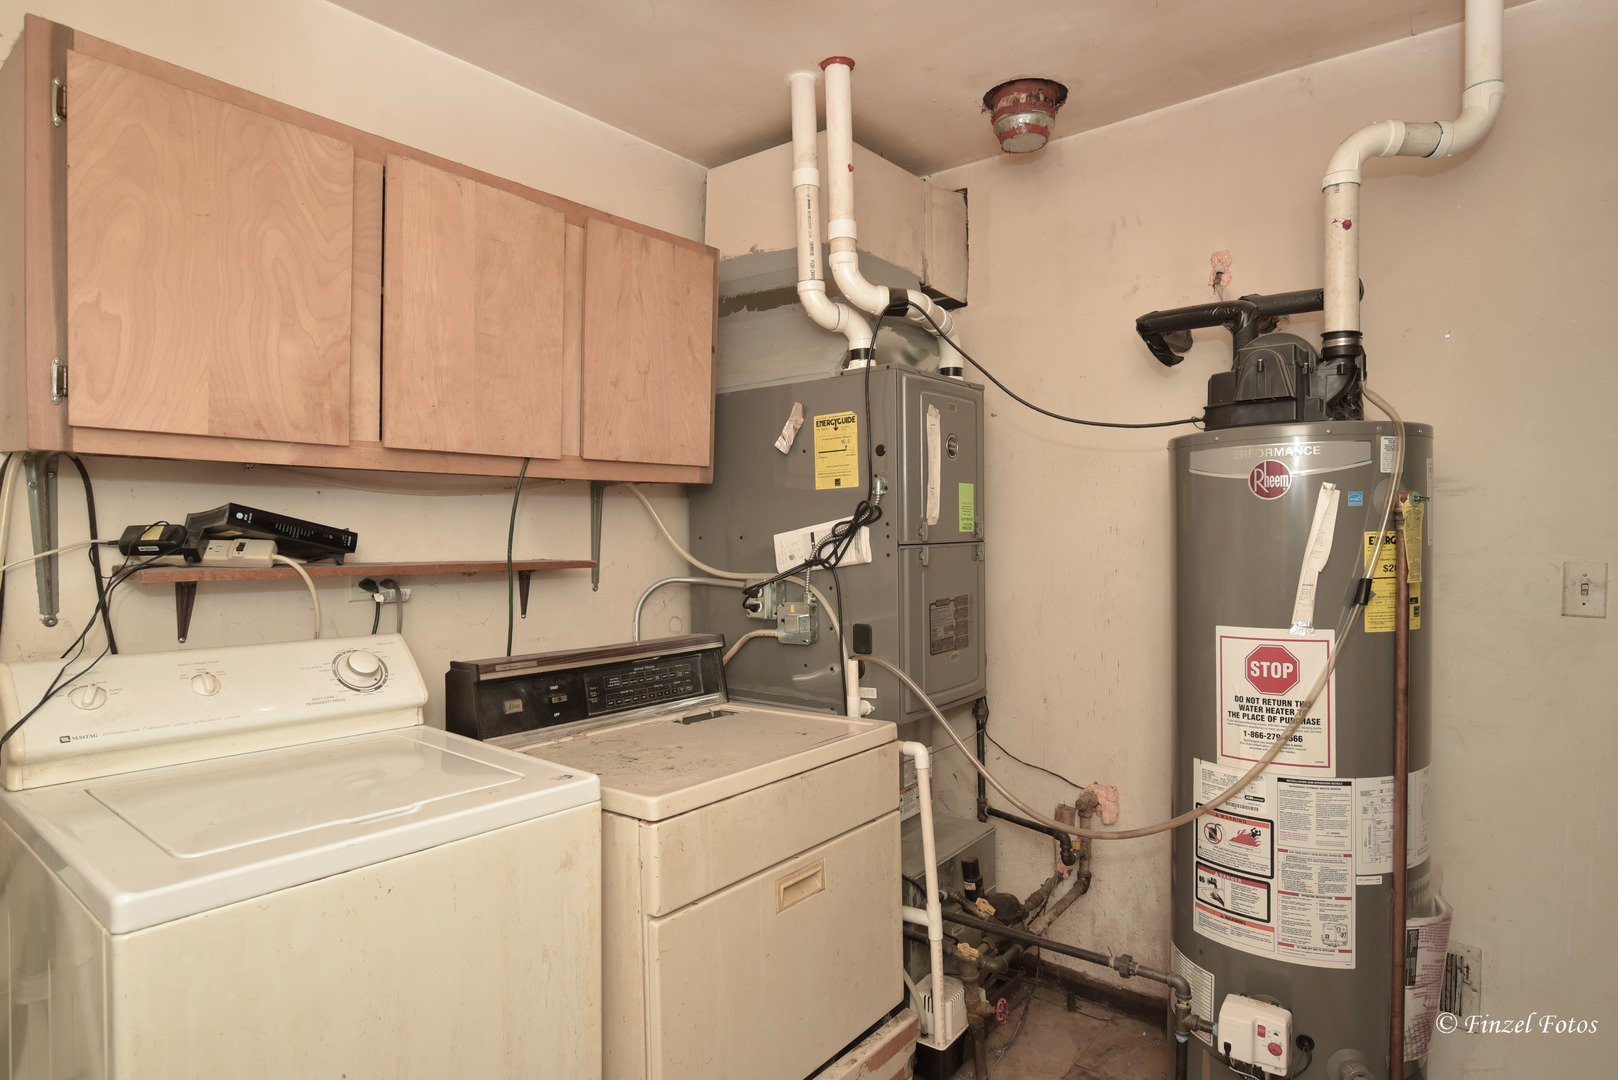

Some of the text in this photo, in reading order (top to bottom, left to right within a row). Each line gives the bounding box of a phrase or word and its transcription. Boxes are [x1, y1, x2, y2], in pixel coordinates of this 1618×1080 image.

[816, 416, 856, 428] ENERGYGUIDE
[1227, 445, 1321, 460] PERFORMANCE
[1254, 461, 1288, 492] Rheem
[1250, 660, 1294, 678] STOP
[1246, 697, 1260, 705] NOT
[1262, 698, 1292, 707] RETURN
[1239, 704, 1263, 713] WATER
[1266, 707, 1295, 716] HEATER
[1228, 710, 1240, 719] THE
[1242, 712, 1265, 722] PLACE
[1280, 716, 1321, 726] PUHASE
[1243, 730, 1303, 743] 1-866-279566
[1220, 814, 1247, 824] WARNING
[1220, 872, 1242, 883] DANGER
[1225, 914, 1246, 925] WARNING
